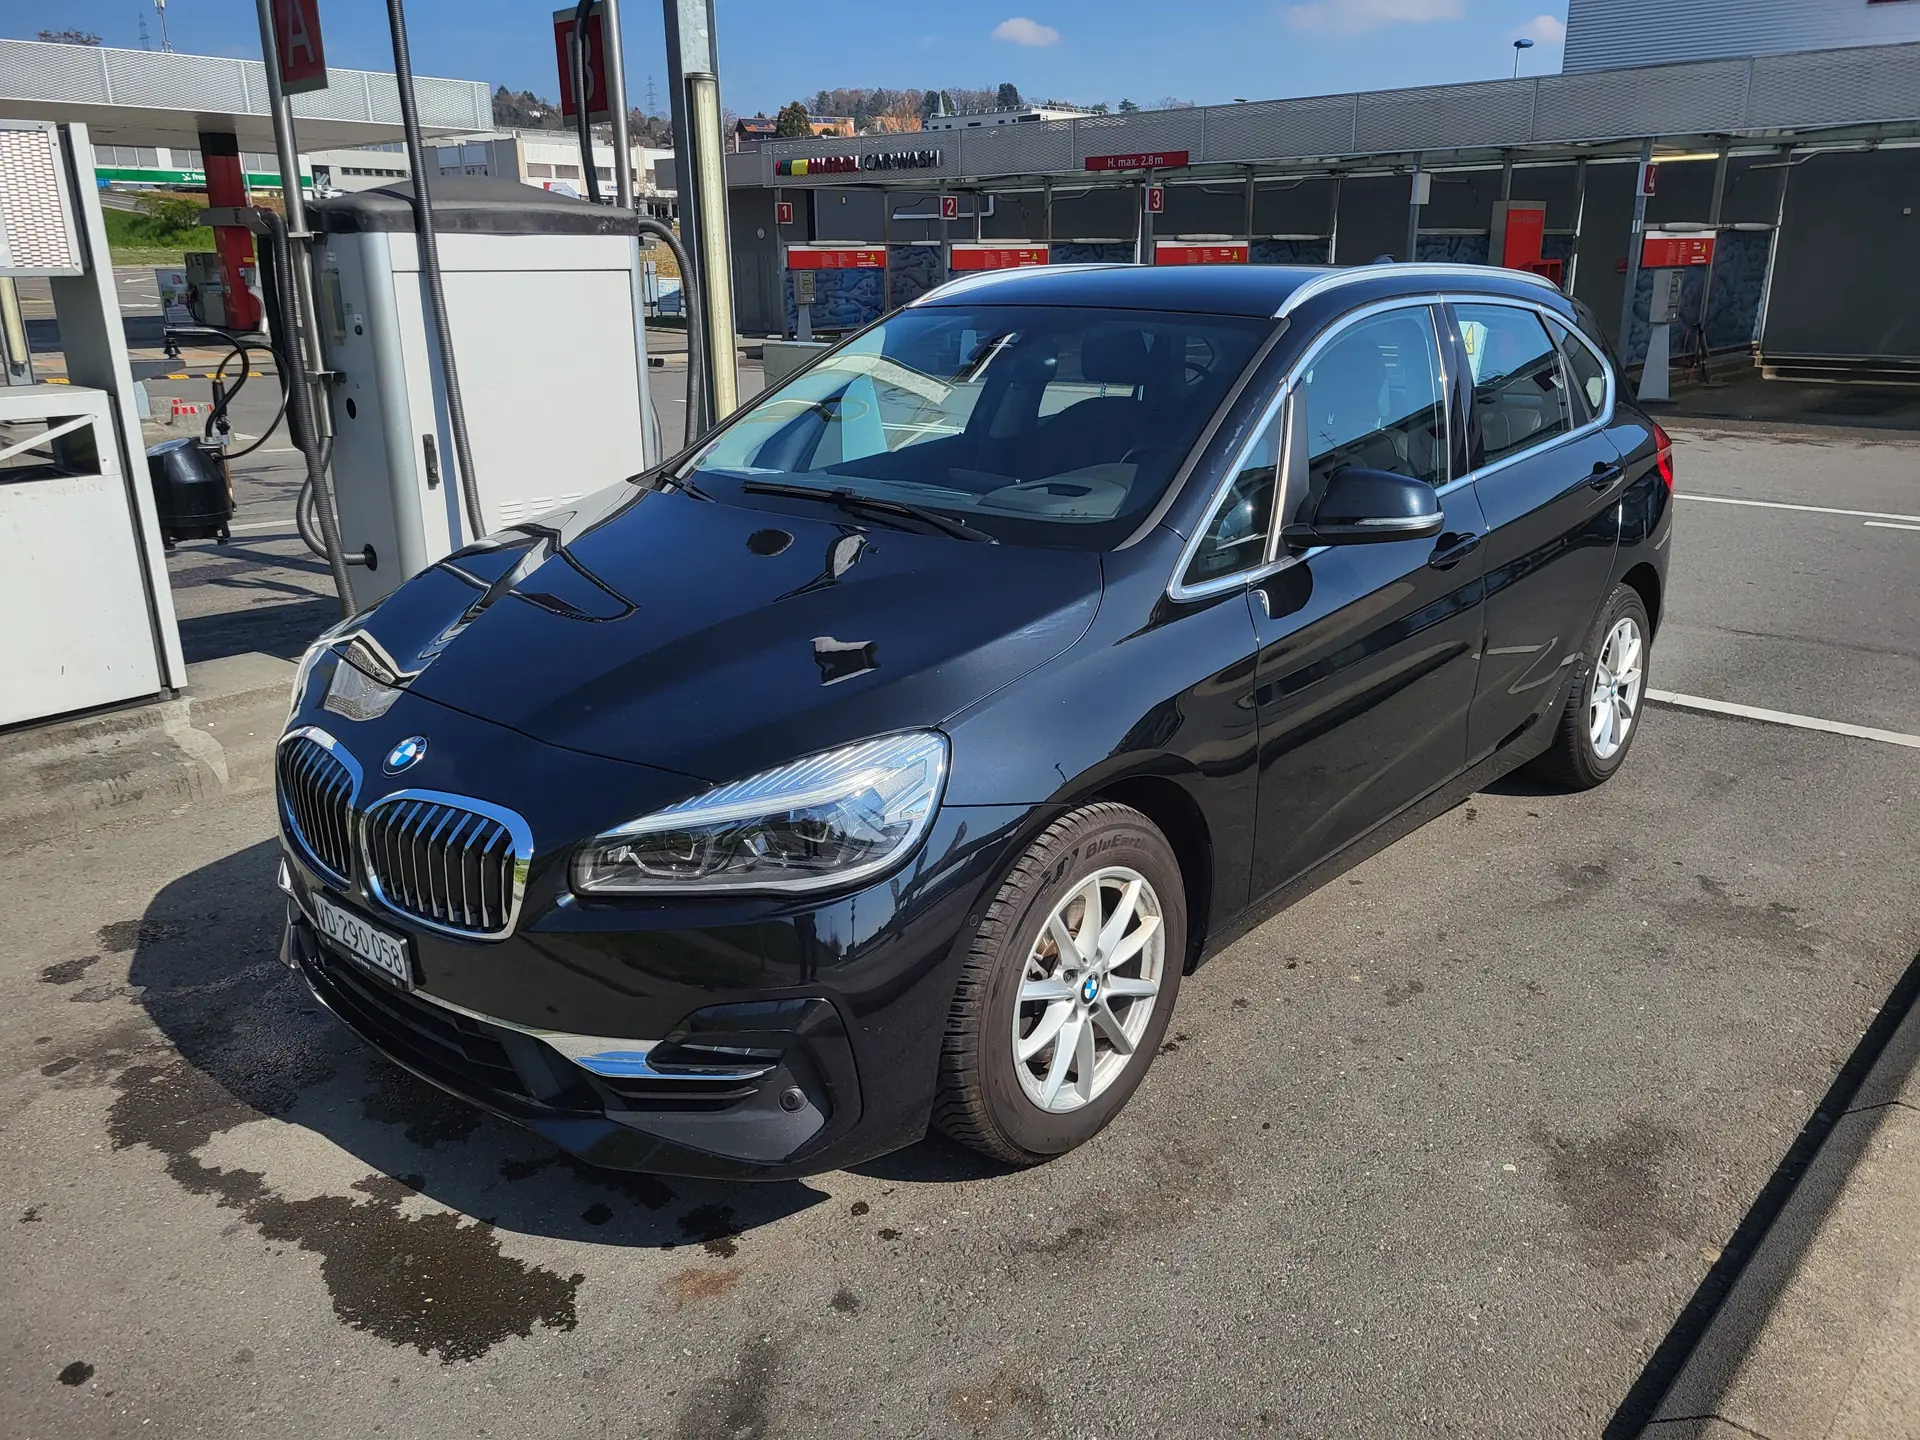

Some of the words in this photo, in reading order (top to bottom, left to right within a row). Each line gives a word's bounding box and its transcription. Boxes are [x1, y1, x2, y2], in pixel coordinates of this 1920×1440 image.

[288, 0, 315, 67] A
[1118, 158, 1139, 167] max.
[1648, 167, 1656, 191] 4
[946, 199, 954, 216] 2
[1153, 190, 1160, 209] 3
[781, 205, 788, 219] 1
